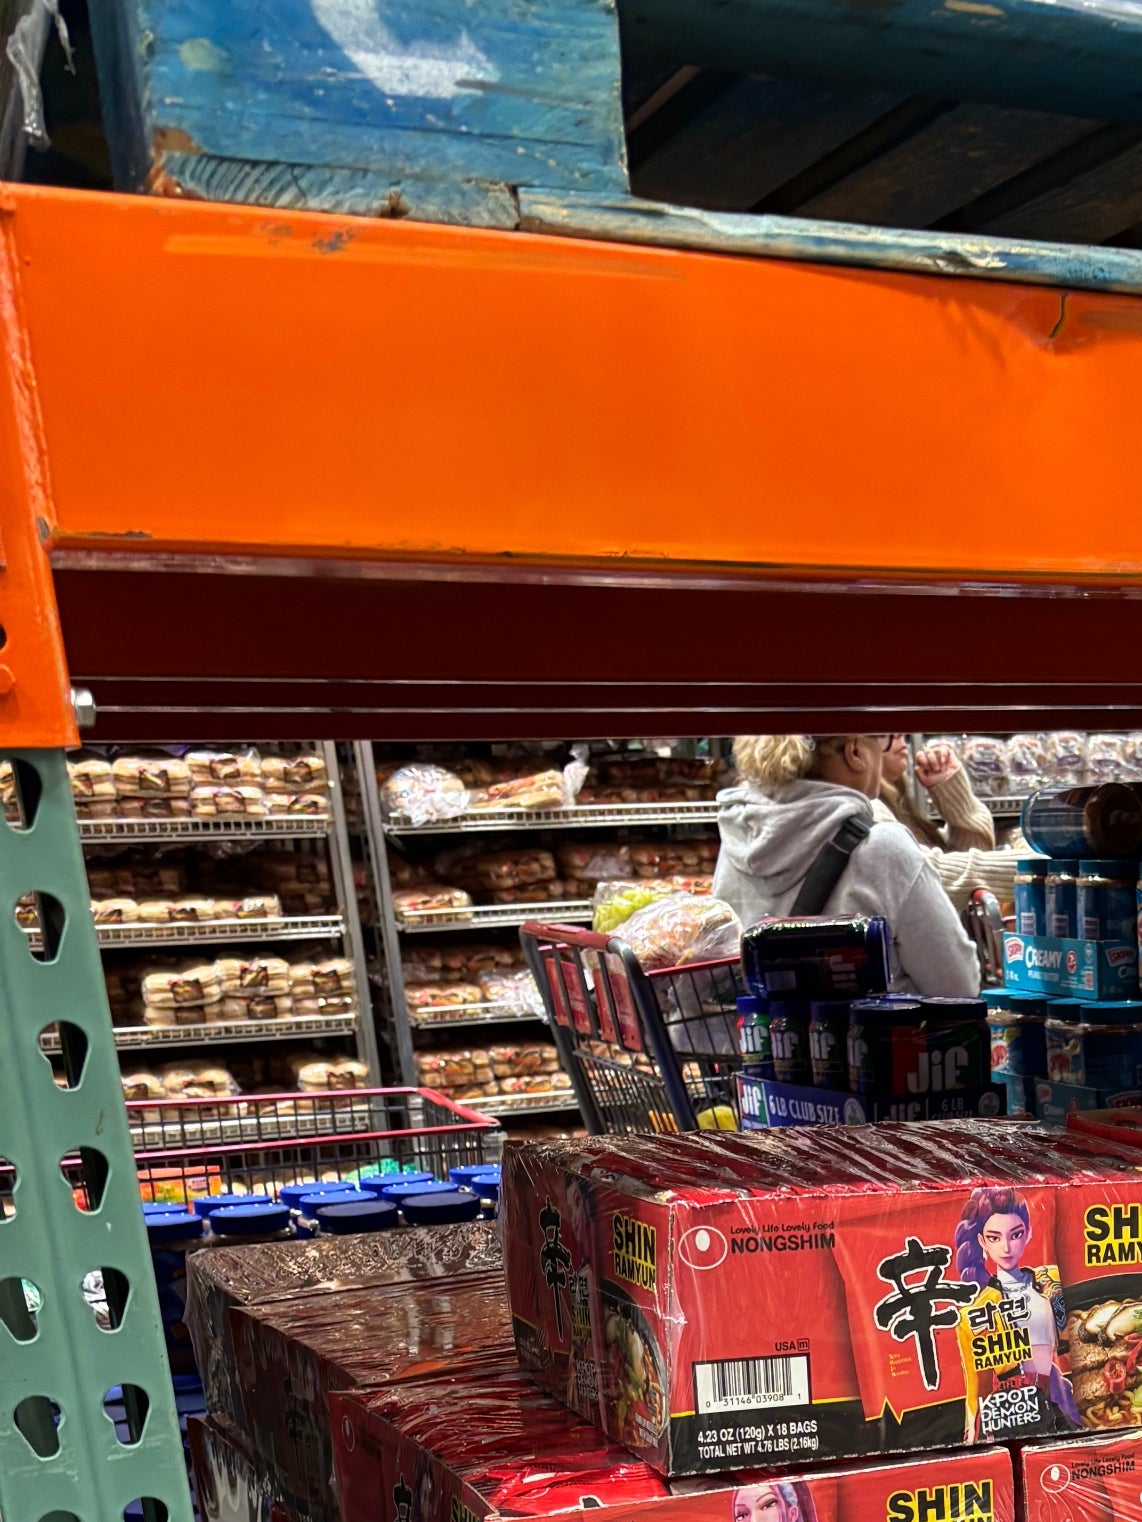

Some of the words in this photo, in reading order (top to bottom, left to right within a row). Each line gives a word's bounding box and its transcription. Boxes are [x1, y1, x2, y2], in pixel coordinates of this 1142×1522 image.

[1025, 946, 1062, 968] CREAMY
[740, 1025, 768, 1054] Jif
[907, 1046, 969, 1093] Jif
[741, 1083, 762, 1115] Jif
[789, 1099, 815, 1121] CLUB
[817, 1104, 840, 1124] SIZE
[613, 1214, 656, 1267] SHIN
[731, 1225, 759, 1235] Lovely
[763, 1224, 779, 1232] Life
[782, 1223, 810, 1231] Lovely
[813, 1222, 834, 1230] Food
[731, 1234, 835, 1254] NONGSHIM
[614, 1253, 656, 1292] RAMYUN
[873, 1237, 980, 1391] 辛
[967, 1296, 1030, 1331] 라면
[775, 1341, 796, 1351] USA
[972, 1328, 1030, 1357] SHIN
[975, 1348, 1032, 1370] RAMYUN
[723, 1396, 751, 1407] 31146
[756, 1394, 784, 1404] 03908
[980, 1396, 1039, 1422] DEMON
[698, 1429, 717, 1443] 4.23
[720, 1429, 734, 1441] OZ
[736, 1426, 765, 1442] (120g)
[768, 1425, 774, 1436] X
[777, 1424, 787, 1435] 18
[790, 1420, 817, 1433] BAGS
[981, 1410, 1041, 1435] HUNTERS
[698, 1446, 725, 1459] TOTAL
[727, 1444, 741, 1455] NET
[742, 1443, 755, 1454] WT
[757, 1441, 772, 1453] 4.76
[774, 1439, 789, 1451] LBS
[790, 1436, 819, 1450] (2.16kg)
